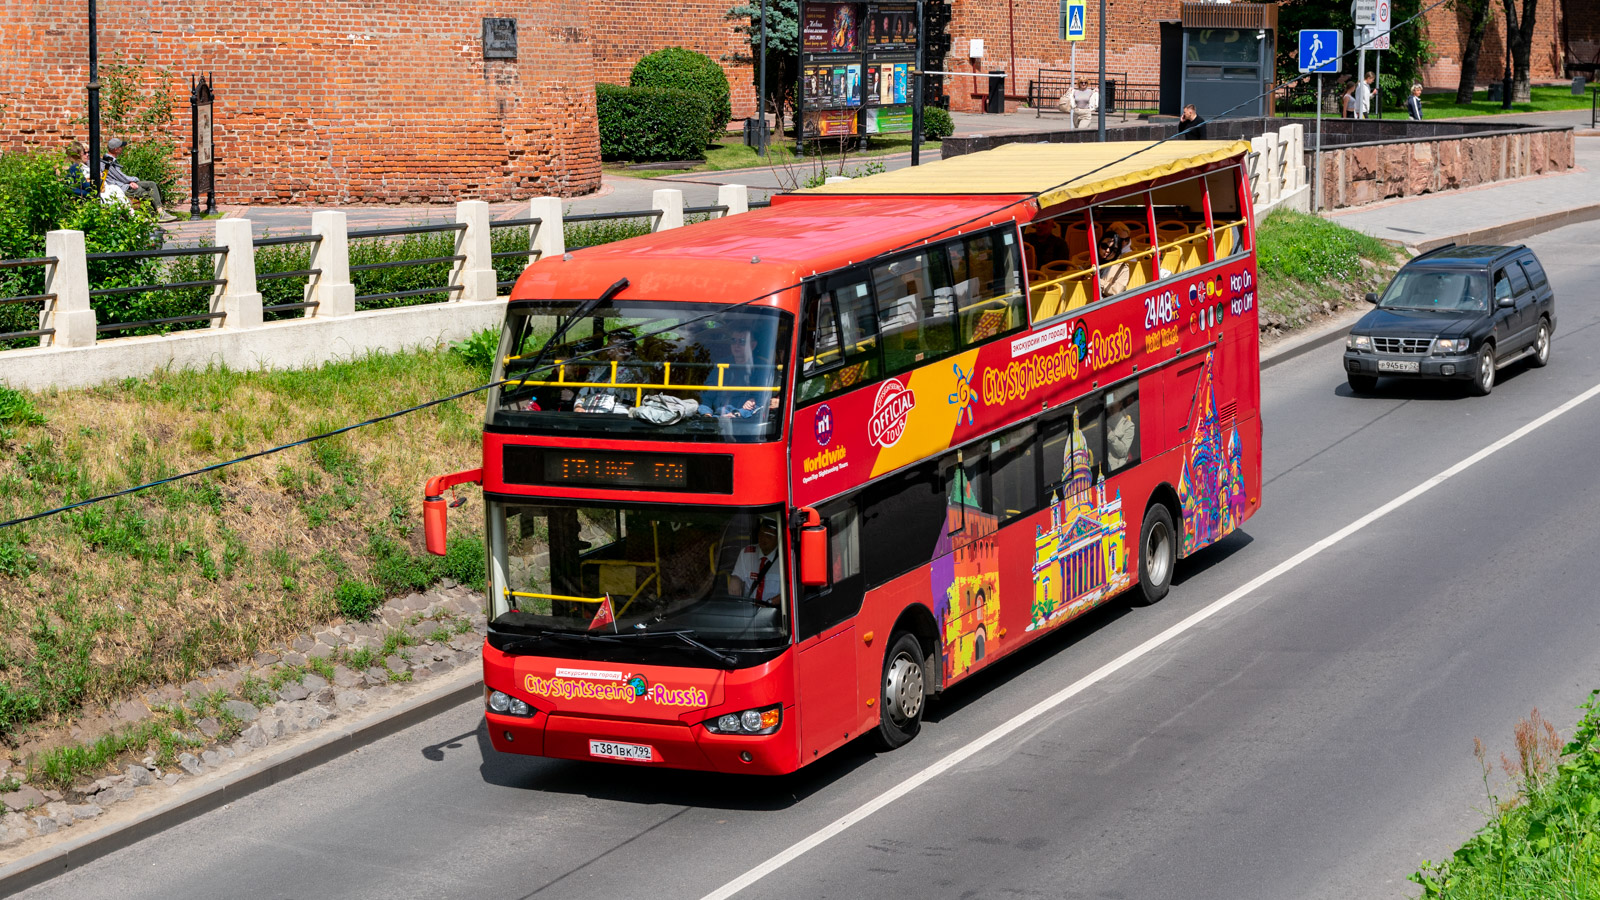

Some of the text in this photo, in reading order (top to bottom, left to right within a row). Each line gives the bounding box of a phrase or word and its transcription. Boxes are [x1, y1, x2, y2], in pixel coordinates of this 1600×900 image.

[1381, 8, 1386, 16] 20
[1230, 269, 1252, 293] Hop On
[1144, 290, 1172, 329] 24/48
[1231, 292, 1254, 316] Hop Off
[1012, 327, 1066, 353] экскурсии по городу
[982, 323, 1132, 406] CitySightseeing Russia
[873, 393, 913, 437] OFFICIAL
[886, 419, 905, 441] TOUR
[803, 445, 846, 473] Worldwide
[838, 462, 849, 470] Tours
[557, 669, 589, 677] экскурсии
[599, 672, 621, 680] городу
[524, 674, 708, 707] CitySightseeing Russia
[633, 745, 649, 756] 799
